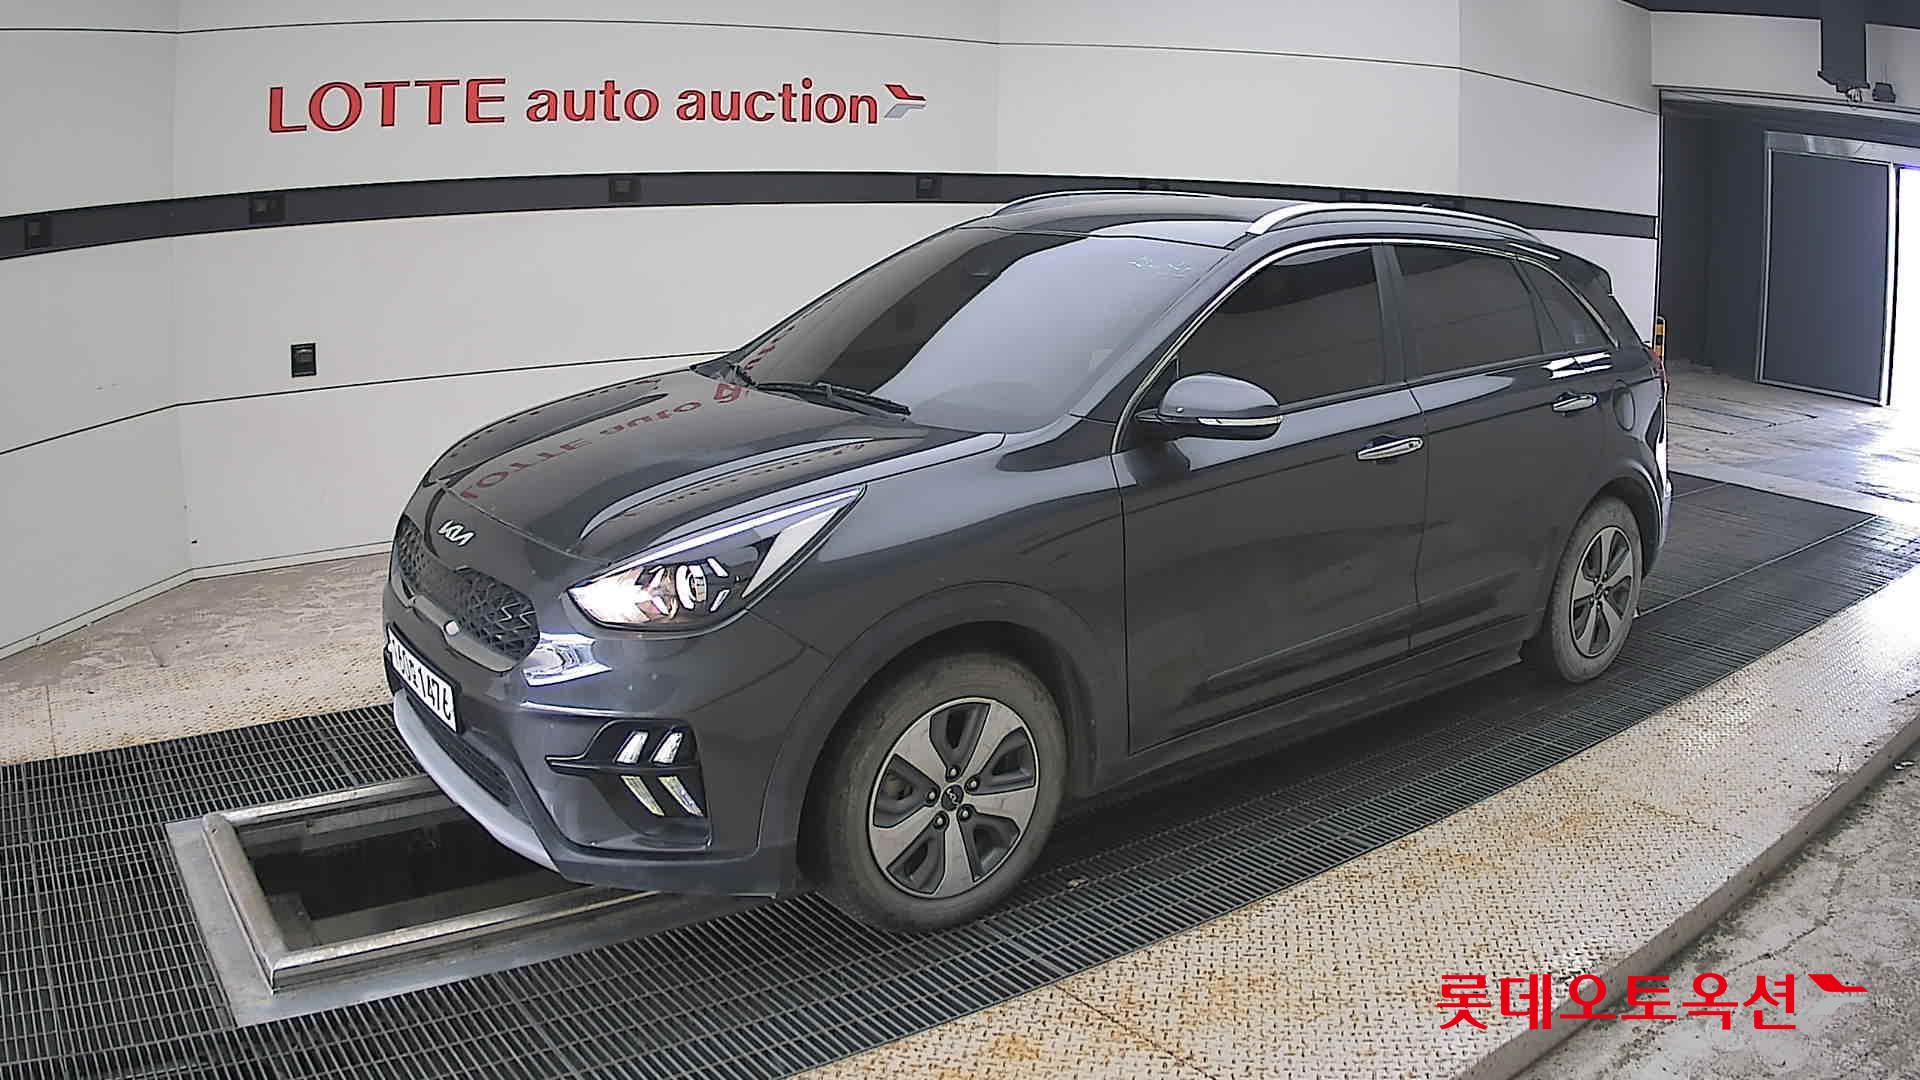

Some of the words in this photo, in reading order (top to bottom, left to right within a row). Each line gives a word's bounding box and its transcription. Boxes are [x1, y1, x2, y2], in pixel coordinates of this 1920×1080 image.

[269, 78, 506, 133] LOTTE
[525, 80, 660, 122] auto
[676, 77, 878, 125] auction
